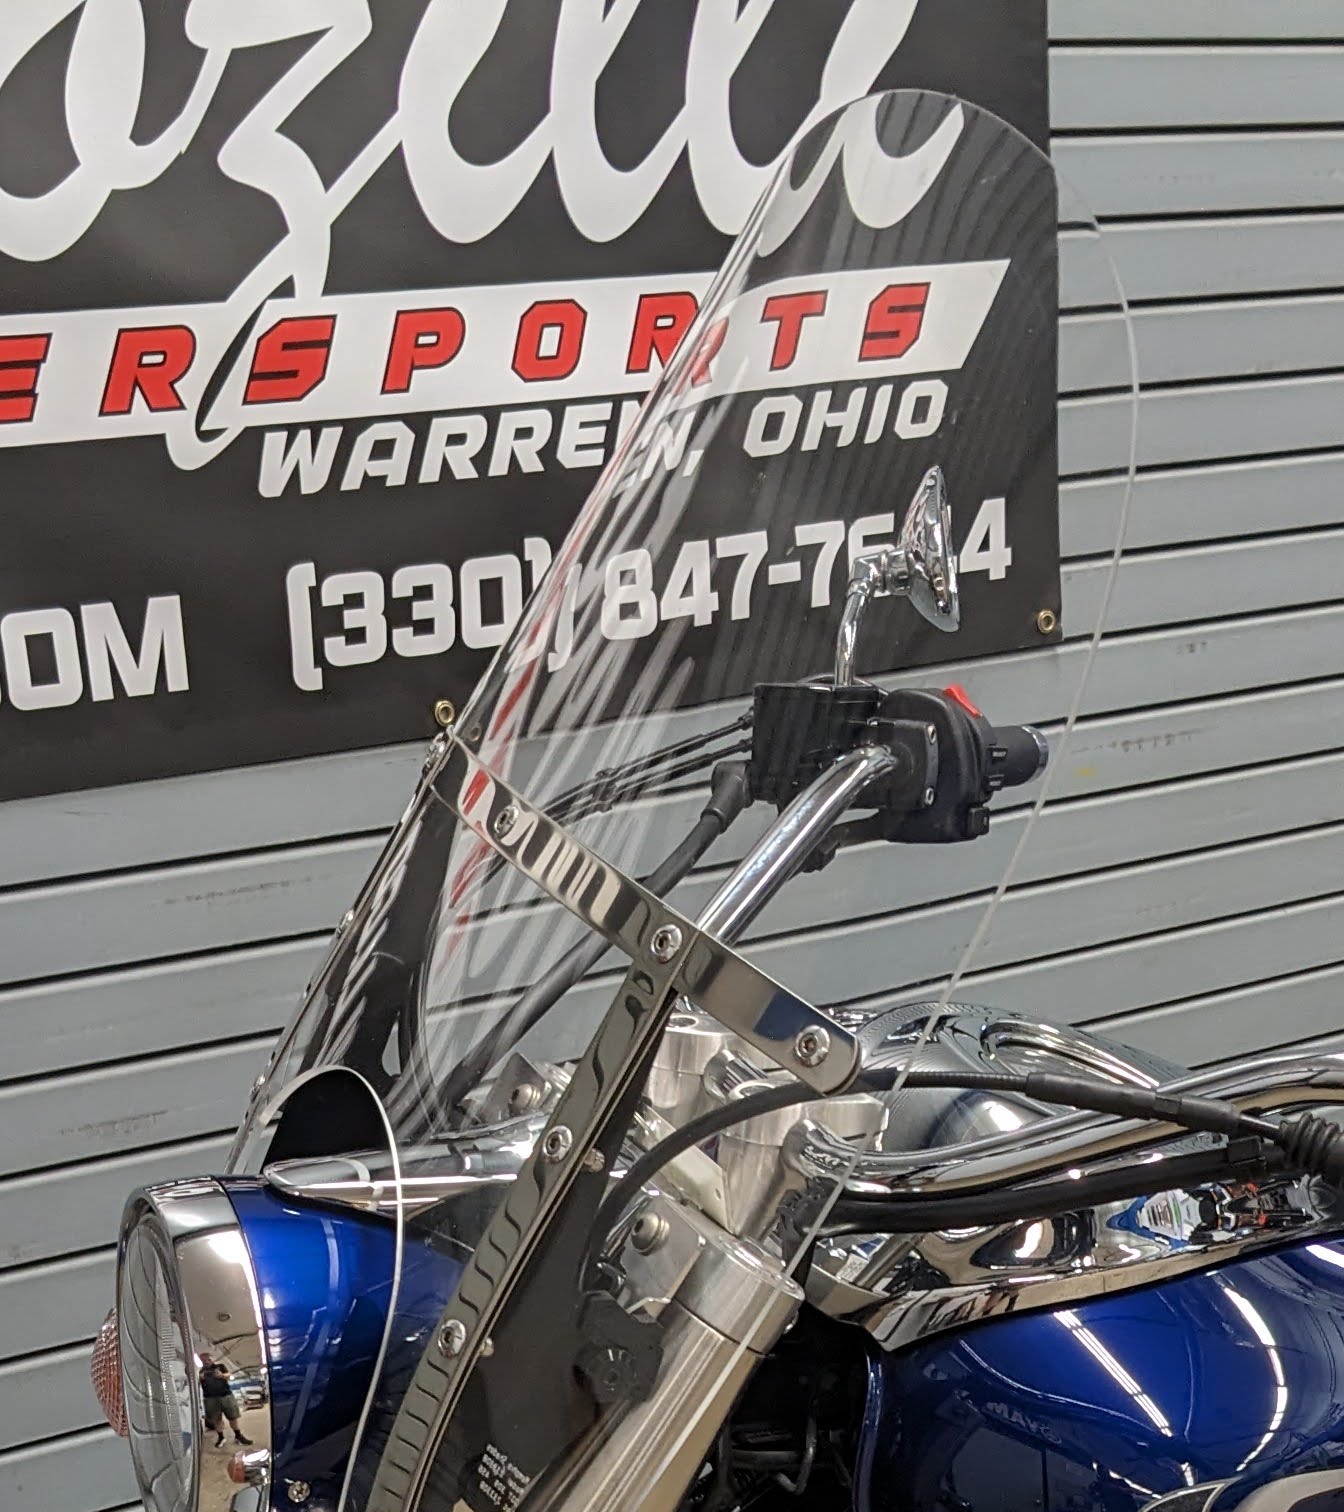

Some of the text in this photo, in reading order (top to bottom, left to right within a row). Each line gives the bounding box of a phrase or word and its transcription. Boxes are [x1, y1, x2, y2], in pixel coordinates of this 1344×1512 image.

[258, 379, 949, 499] WARREN, OHIO
[286, 497, 1013, 692] (330) 847-764
